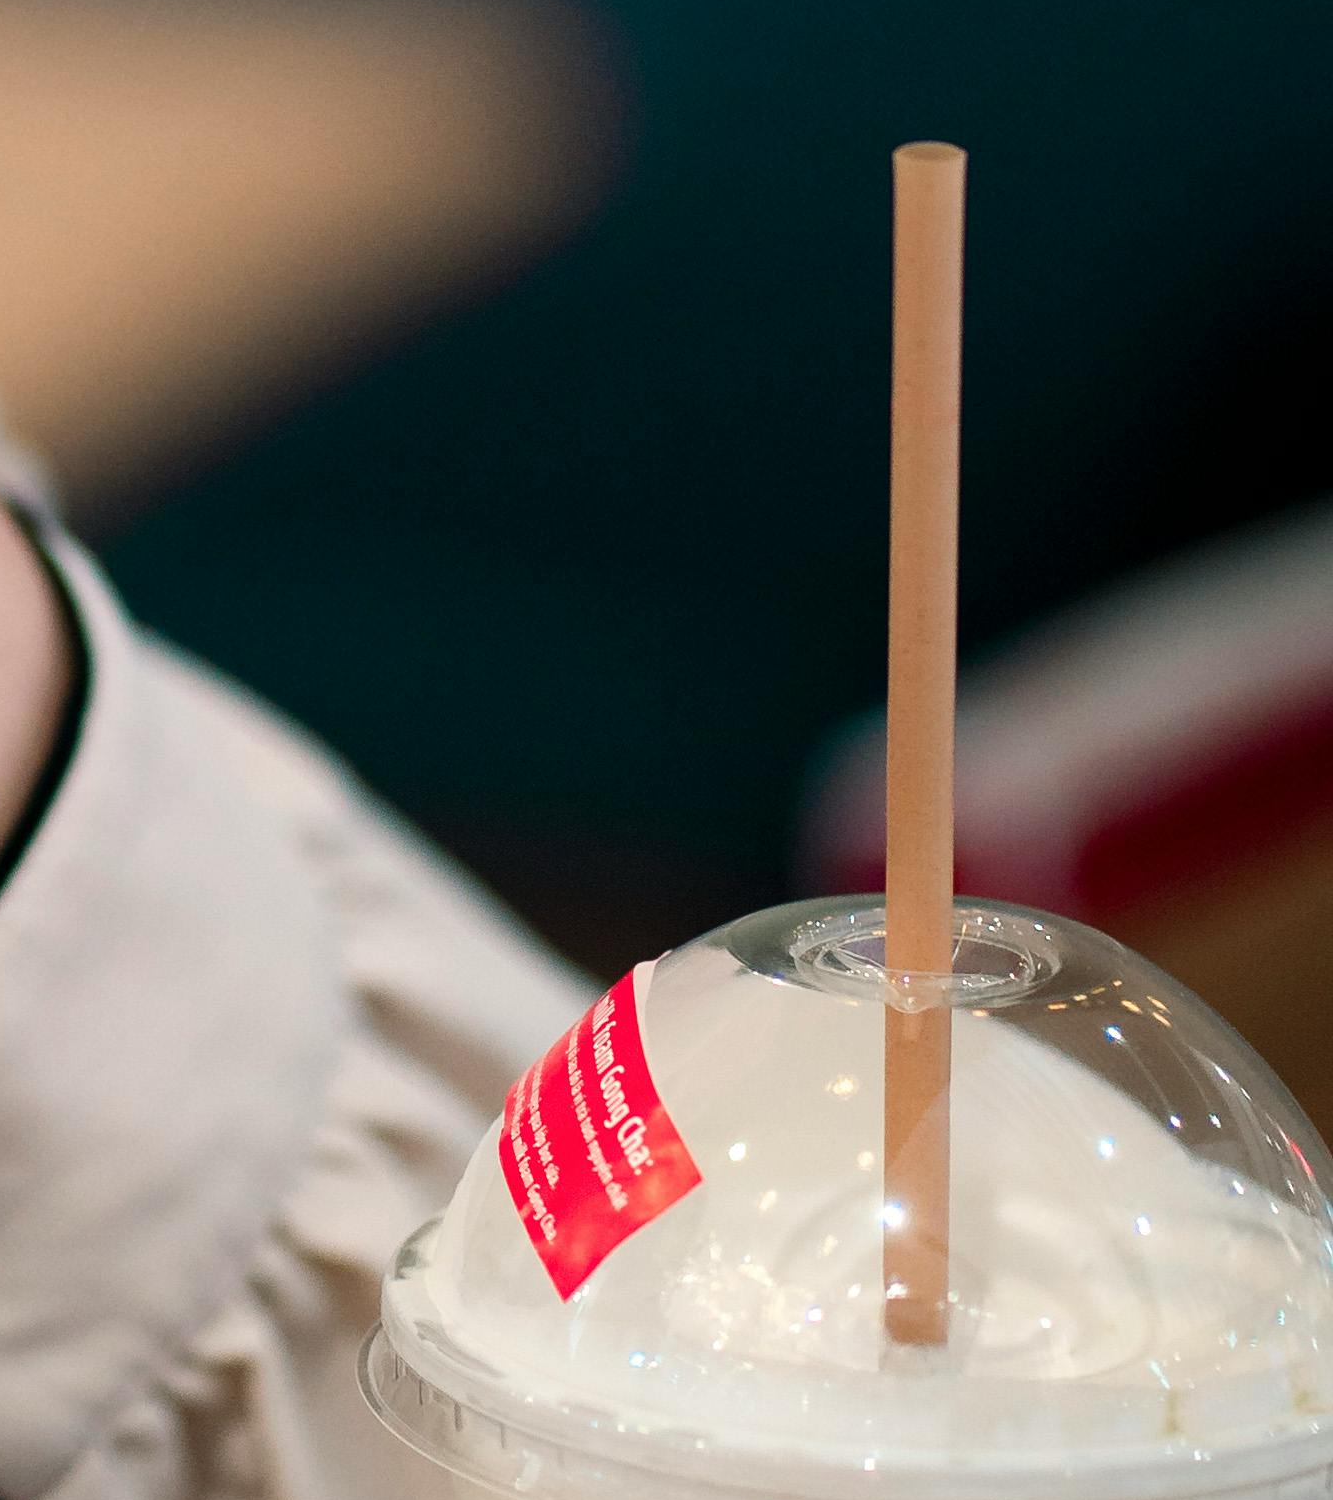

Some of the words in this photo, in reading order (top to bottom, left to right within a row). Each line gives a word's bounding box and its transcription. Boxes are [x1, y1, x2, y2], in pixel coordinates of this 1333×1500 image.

[593, 1020, 617, 1075] foam
[600, 1065, 630, 1129] Gong
[617, 1115, 654, 1176] Cha:
[527, 1183, 547, 1220] Gong
